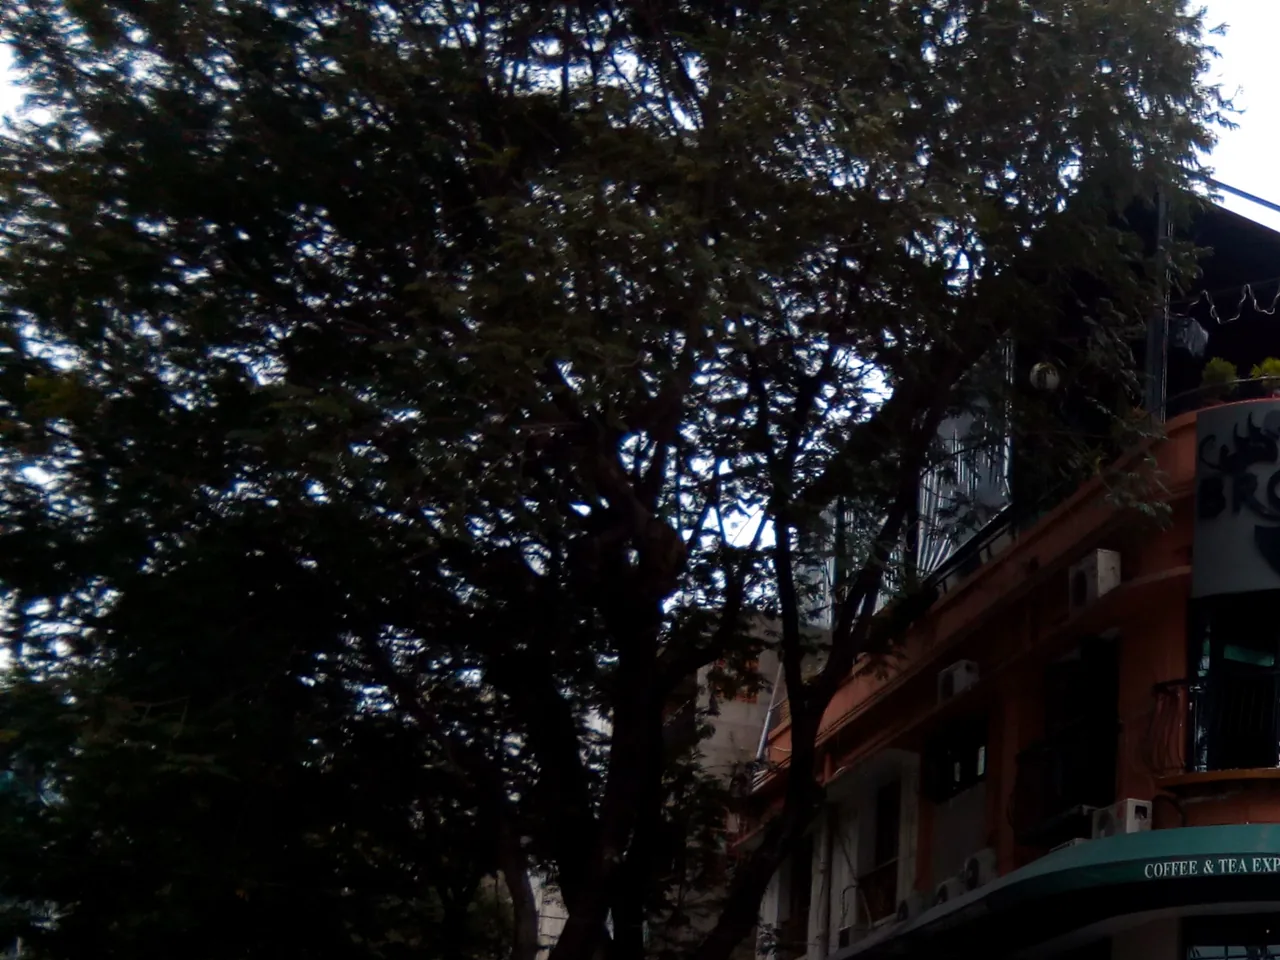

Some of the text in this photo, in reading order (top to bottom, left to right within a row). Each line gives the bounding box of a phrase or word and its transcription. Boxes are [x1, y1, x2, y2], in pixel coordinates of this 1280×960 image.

[1144, 860, 1199, 879] COFFEE
[1203, 859, 1215, 875] &
[1219, 858, 1249, 874] TEA
